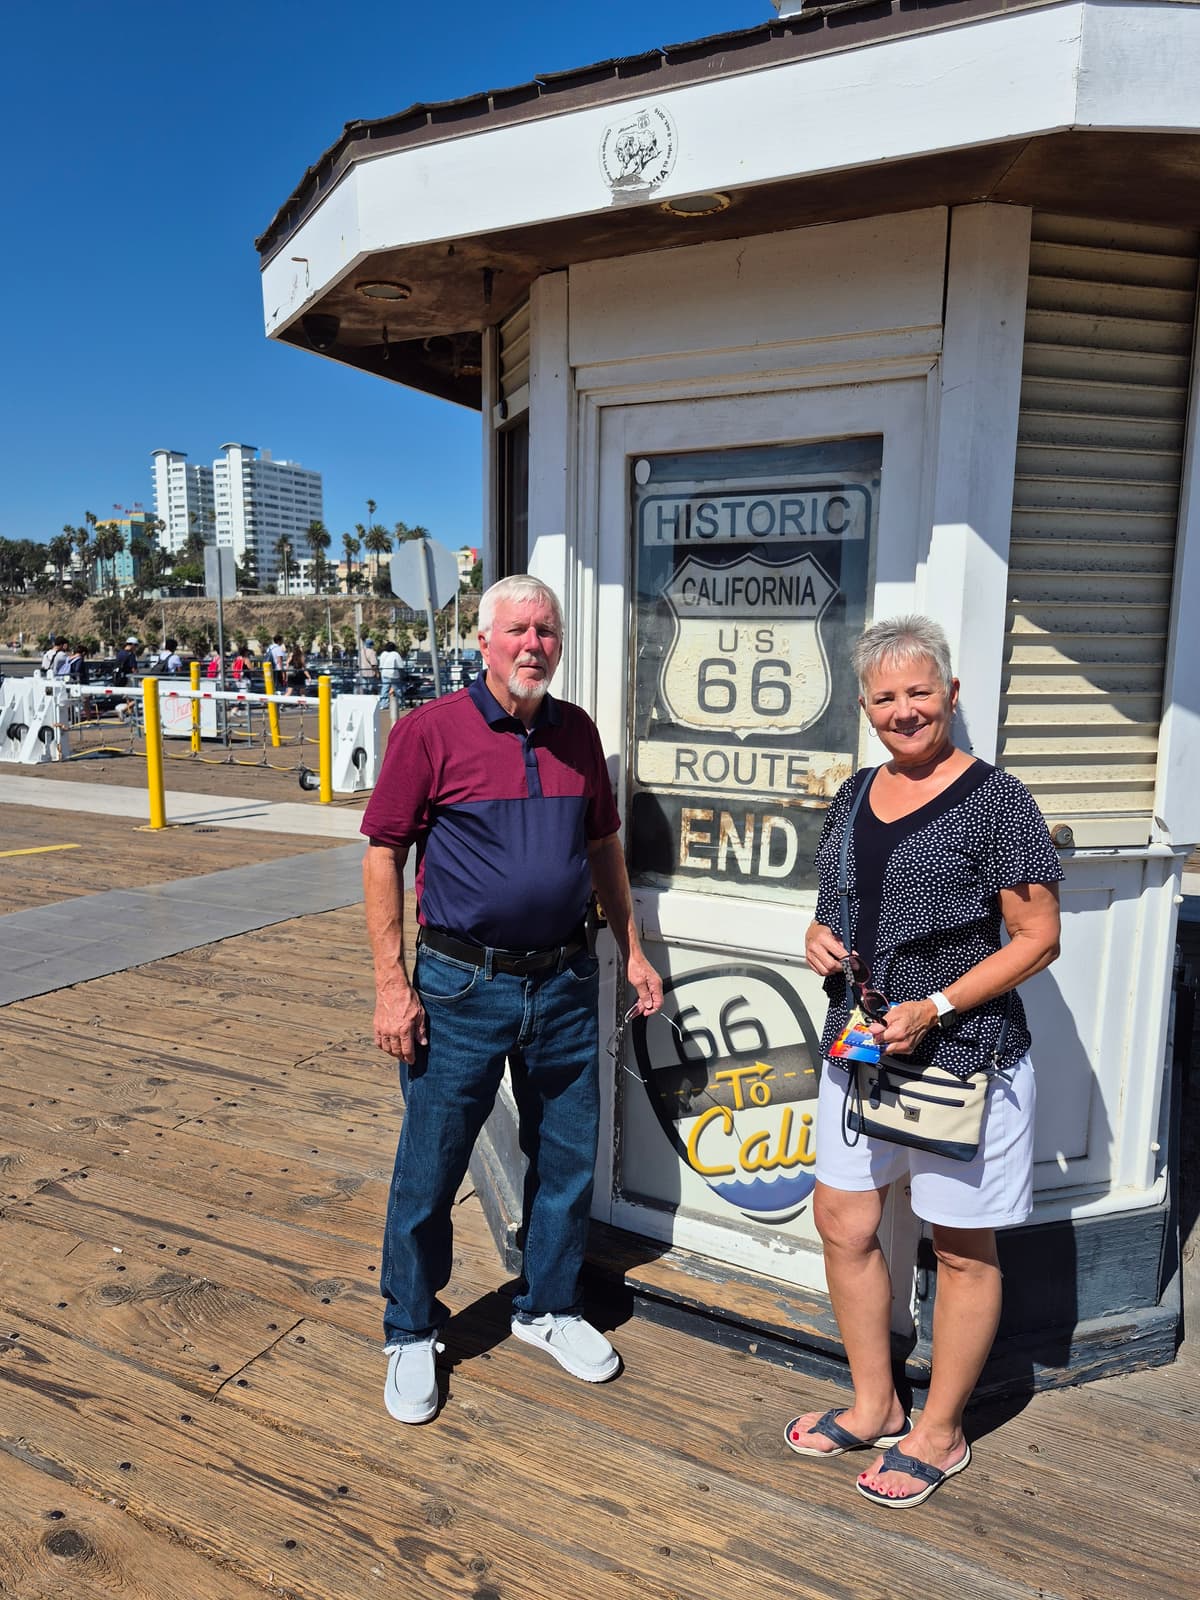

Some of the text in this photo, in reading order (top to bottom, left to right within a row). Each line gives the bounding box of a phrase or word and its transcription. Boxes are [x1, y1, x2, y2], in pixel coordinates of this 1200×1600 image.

[656, 496, 851, 540] HISTORIC
[681, 575, 817, 607] CALIFORNIA
[697, 657, 792, 717] 66
[674, 748, 811, 790] ROUTE
[679, 807, 799, 879] END
[671, 994, 769, 1065] 66
[715, 1061, 774, 1110] To
[687, 1106, 817, 1176] Cali
